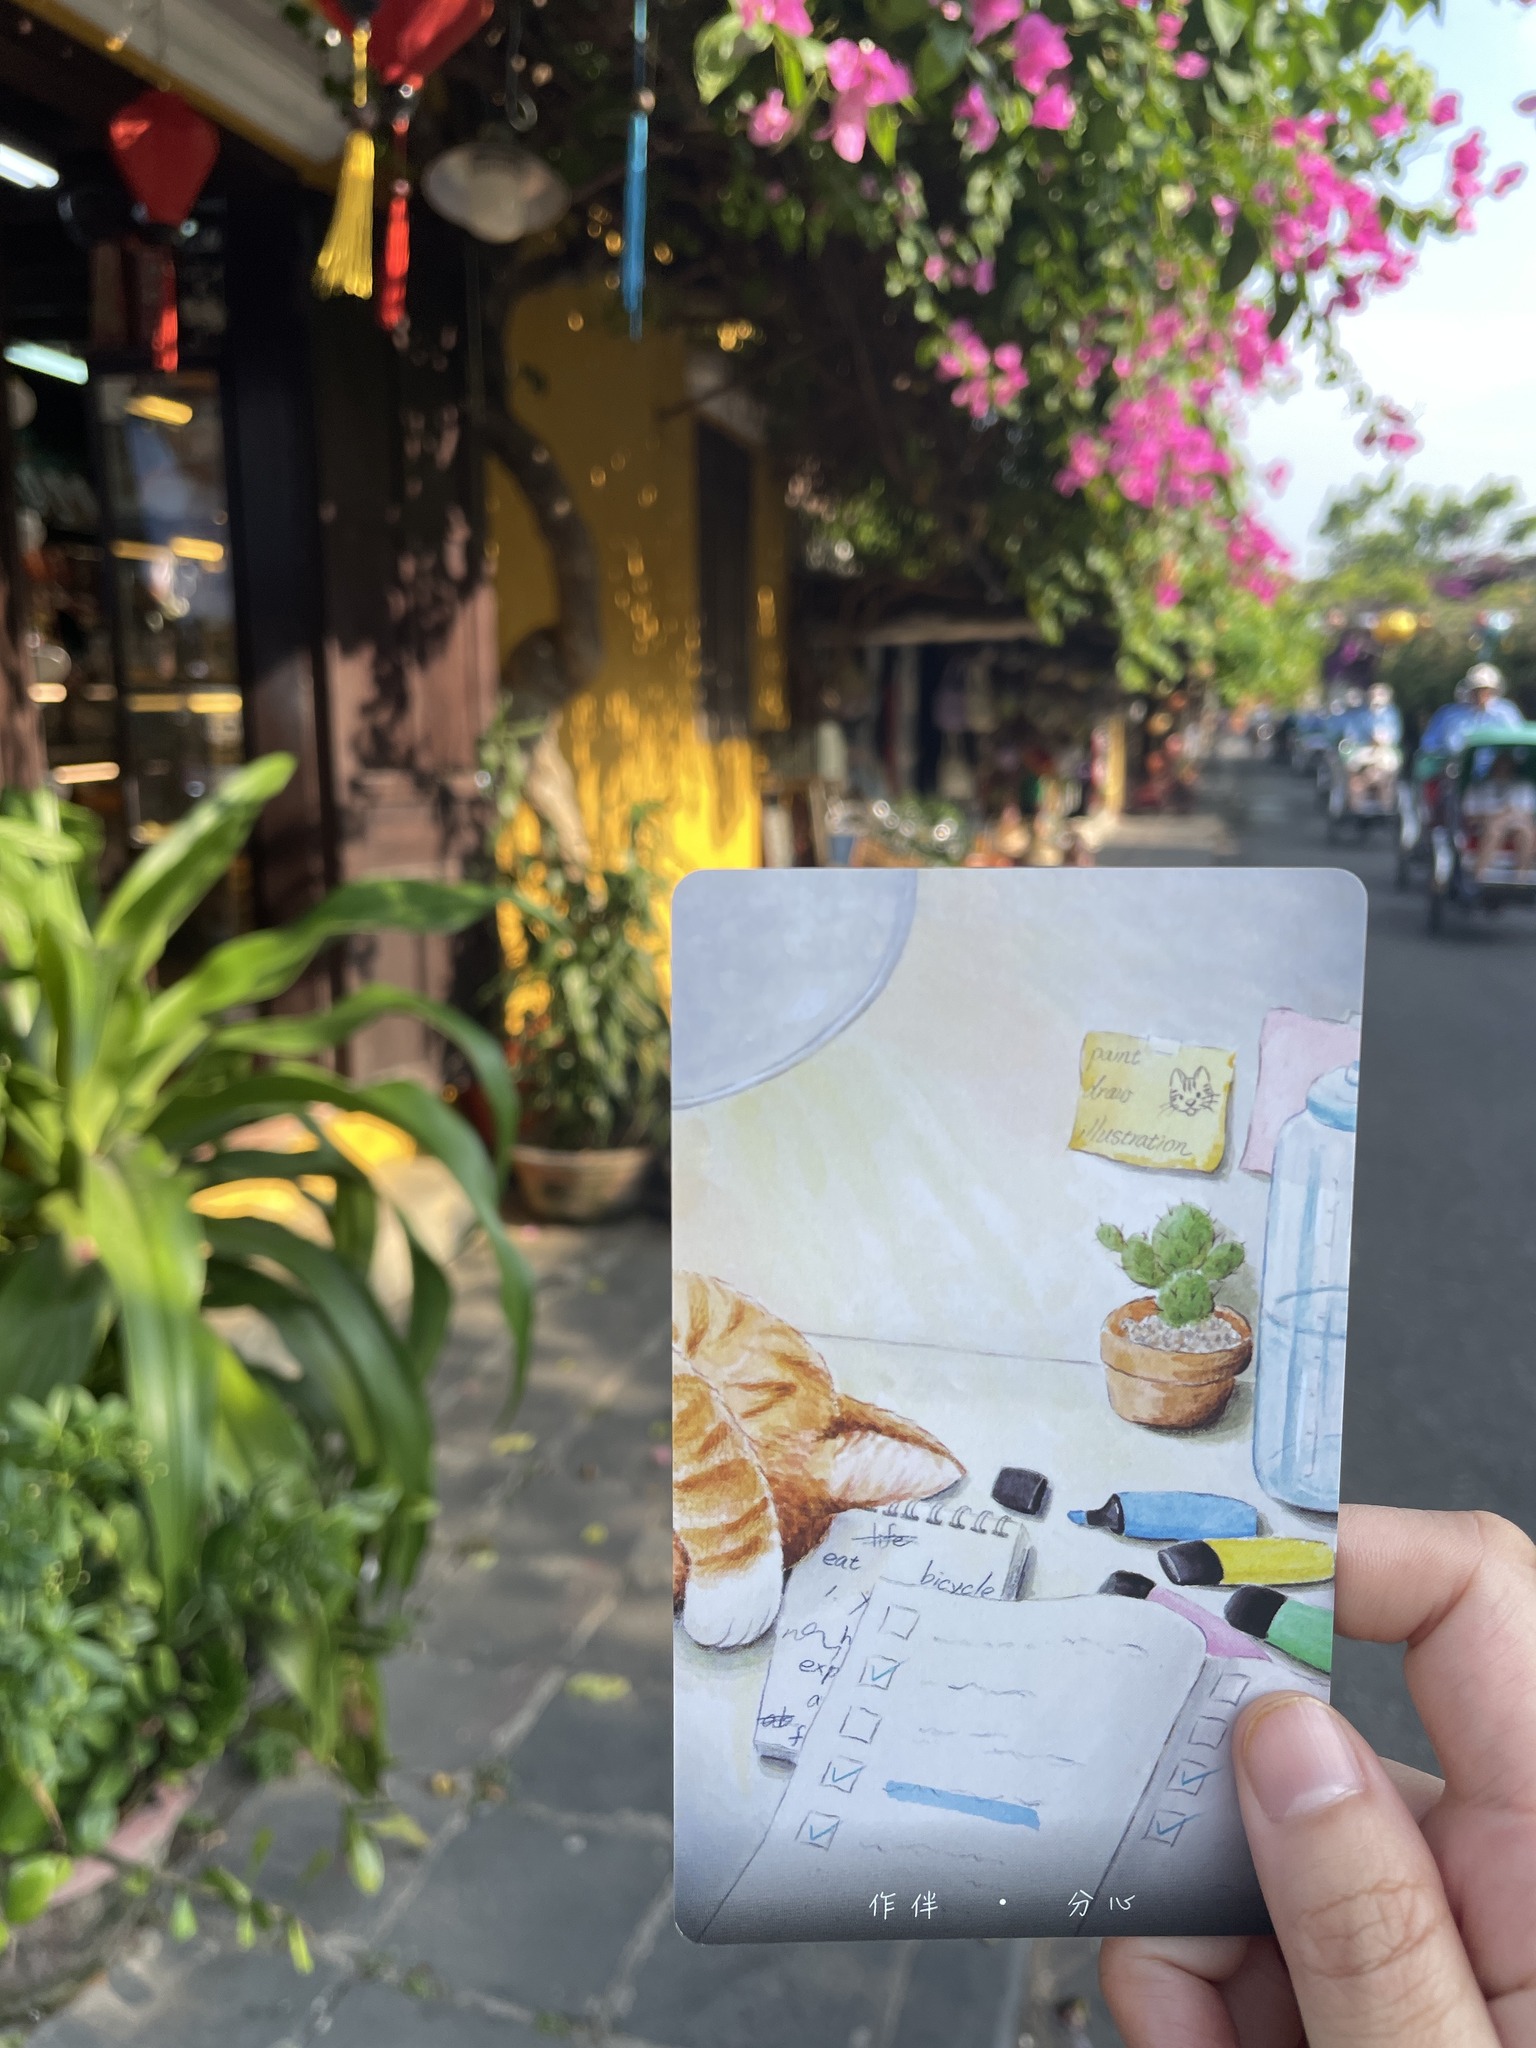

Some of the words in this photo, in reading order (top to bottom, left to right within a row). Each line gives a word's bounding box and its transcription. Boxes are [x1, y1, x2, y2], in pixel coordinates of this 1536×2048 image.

[1077, 1114, 1192, 1156] illustration
[822, 1552, 862, 1570] eat
[920, 1560, 995, 1598] bicycle
[799, 1659, 840, 1685] exp
